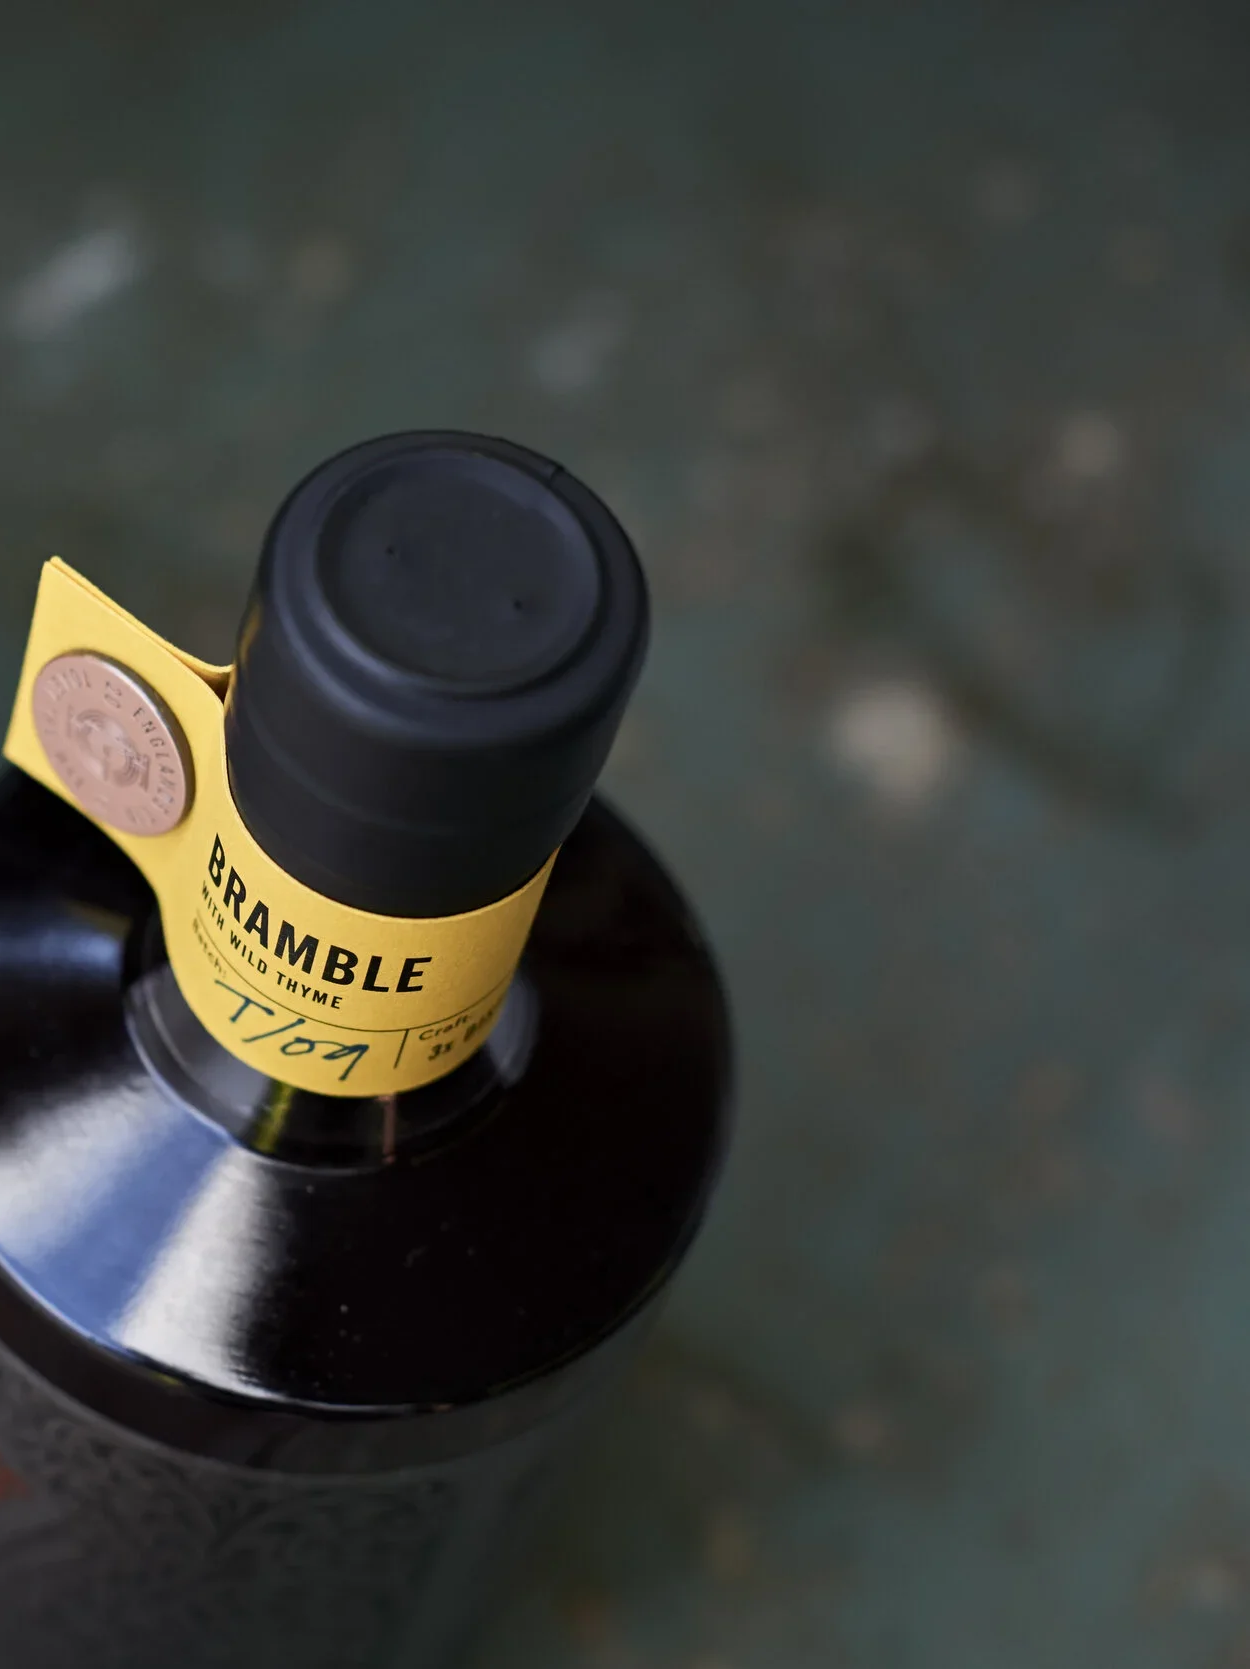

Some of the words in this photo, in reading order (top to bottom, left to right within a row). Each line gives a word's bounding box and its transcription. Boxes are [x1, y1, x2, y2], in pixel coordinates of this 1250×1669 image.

[201, 881, 223, 932] WITH
[230, 930, 267, 974] WILD
[276, 971, 342, 1010] THYME
[208, 833, 432, 993] BRAMBLE
